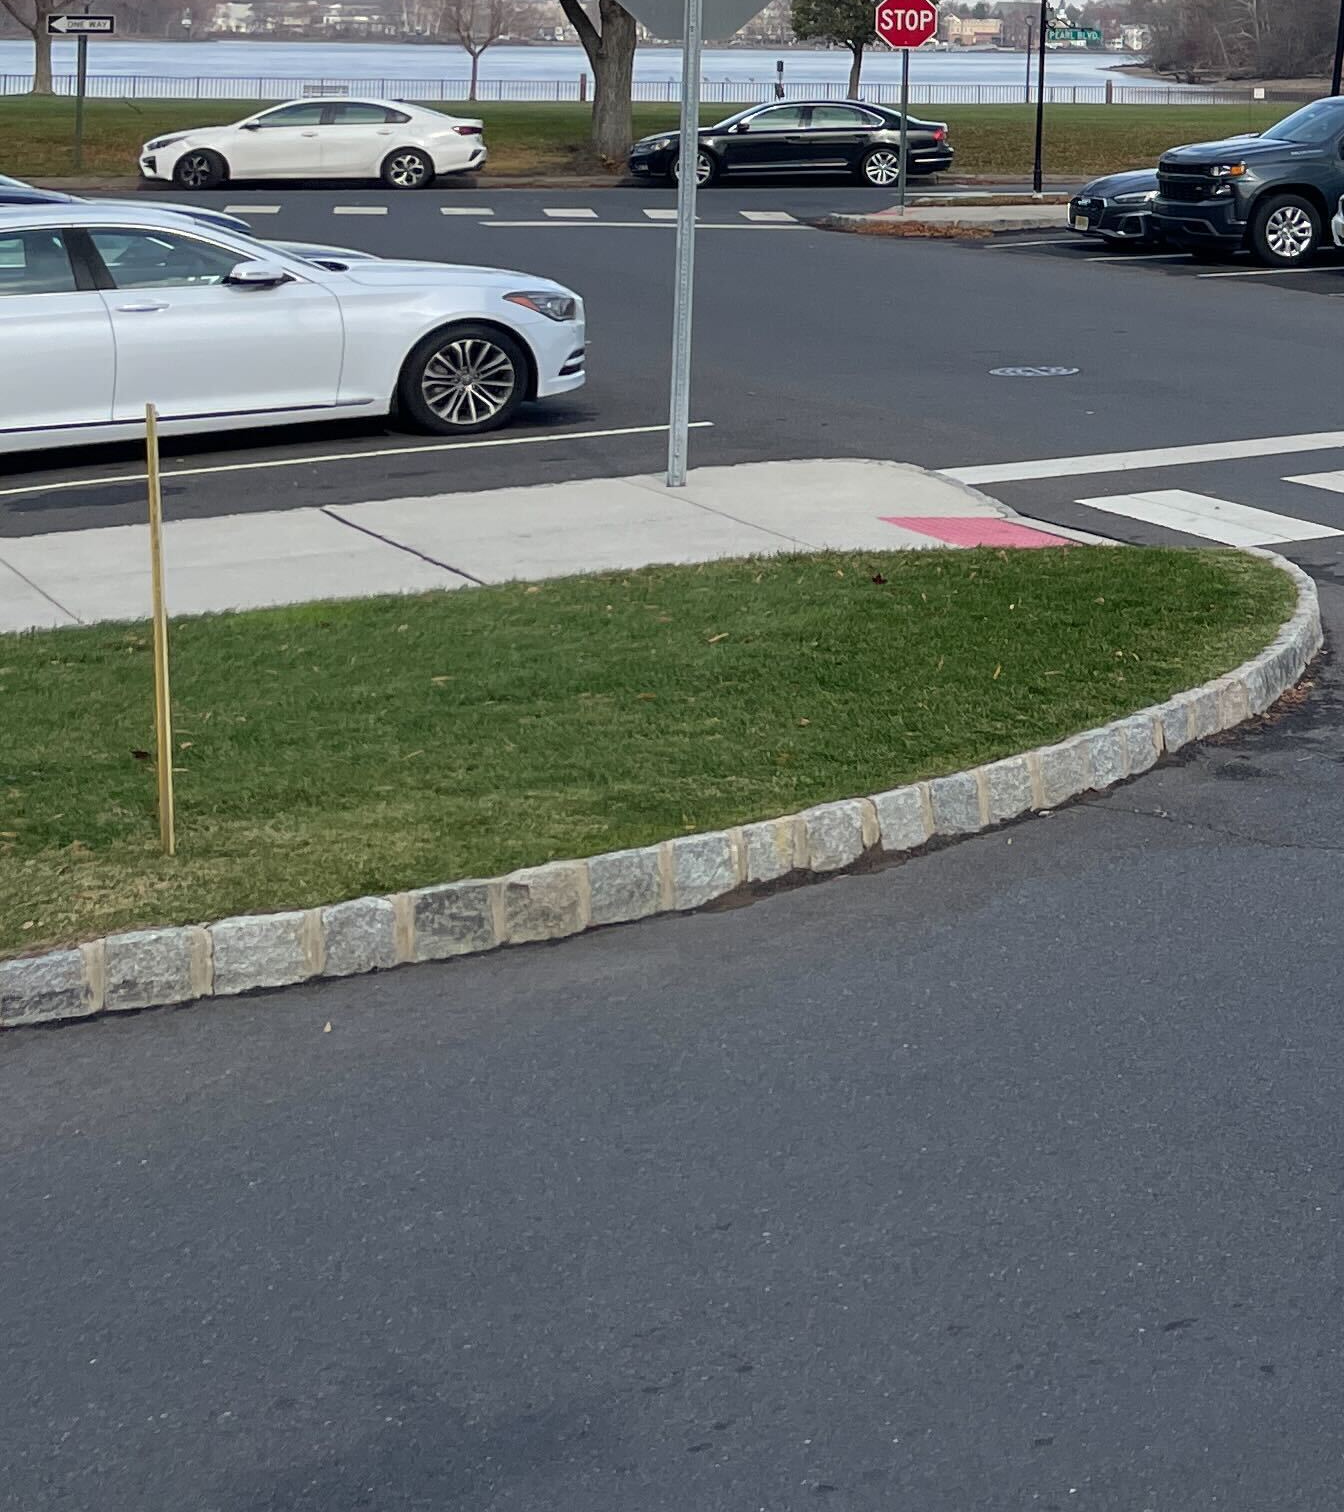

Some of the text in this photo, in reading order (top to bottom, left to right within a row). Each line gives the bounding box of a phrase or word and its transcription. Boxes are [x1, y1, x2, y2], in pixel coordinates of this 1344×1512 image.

[67, 20, 108, 28] ONE WAY
[880, 9, 933, 31] STOP
[1049, 30, 1075, 39] PEARL
